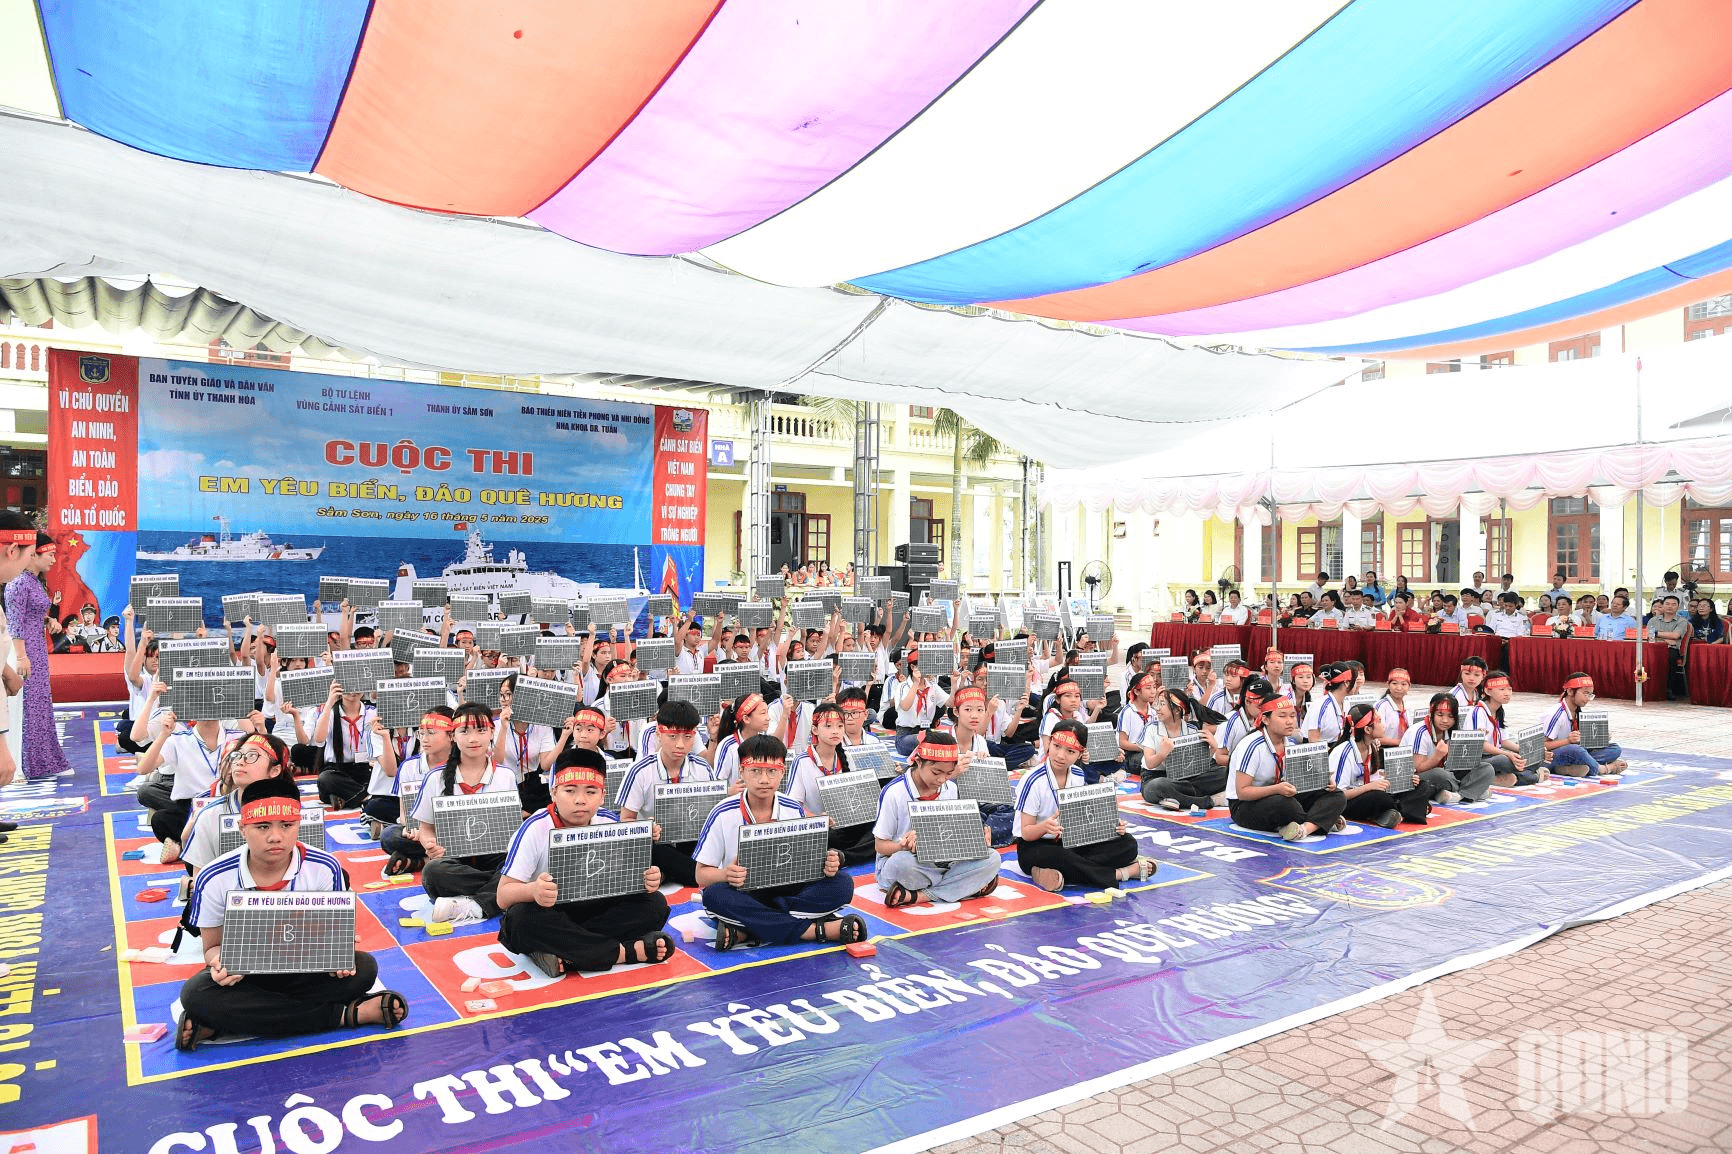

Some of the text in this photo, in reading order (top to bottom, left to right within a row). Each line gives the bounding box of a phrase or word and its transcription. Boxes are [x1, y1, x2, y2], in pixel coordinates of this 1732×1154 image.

[149, 373, 167, 384] BAN
[59, 387, 129, 413] VÌ CHỦ QUYỀN
[206, 392, 236, 404] THANH
[321, 386, 371, 402] BỘ TƯ LỆNH
[296, 399, 393, 417] VÙNG CẢNH SÁT BIỂN 1
[588, 411, 610, 422] PHONG
[621, 413, 632, 423] NHI
[71, 420, 117, 442] AN NINH,
[660, 434, 703, 455] CẢNH SÁT BIỂN
[72, 447, 116, 469] AN TOÀN
[325, 438, 533, 476] CUỘC THI
[717, 452, 728, 463] A
[667, 459, 695, 478] VIỆT NAM
[68, 472, 118, 498] BIỂN, ĐẢO
[198, 475, 623, 510] EM YÊU BIỂN, ĐẢO QUÊ HƯƠNG
[665, 483, 696, 498] CHUNG TAY
[61, 503, 126, 527] CỦA TỔ QUỐC
[316, 506, 549, 524] Sầm Sơn, ngày 16 tháng 5 năm 2025
[499, 582, 513, 590] NAM
[212, 686, 225, 704] B
[466, 816, 488, 841] B
[566, 833, 577, 842] EM
[577, 830, 588, 841] YÊU
[617, 826, 629, 837] QUÊ
[630, 826, 649, 836] HƯƠNG
[763, 826, 773, 835] YÊU
[798, 822, 809, 831] QUÊ
[809, 821, 826, 830] HƯƠNG
[585, 849, 606, 878] B
[248, 894, 351, 906] EM YÊU BIỂN ĐẢO QUÊ HƯƠNG
[283, 923, 295, 942] B
[412, 1056, 571, 1125] THI
[686, 996, 842, 1055] YÊU
[826, 963, 1011, 1024] BIỂN,
[969, 943, 1096, 989] ĐẢO
[1077, 919, 1193, 965] QUÊ
